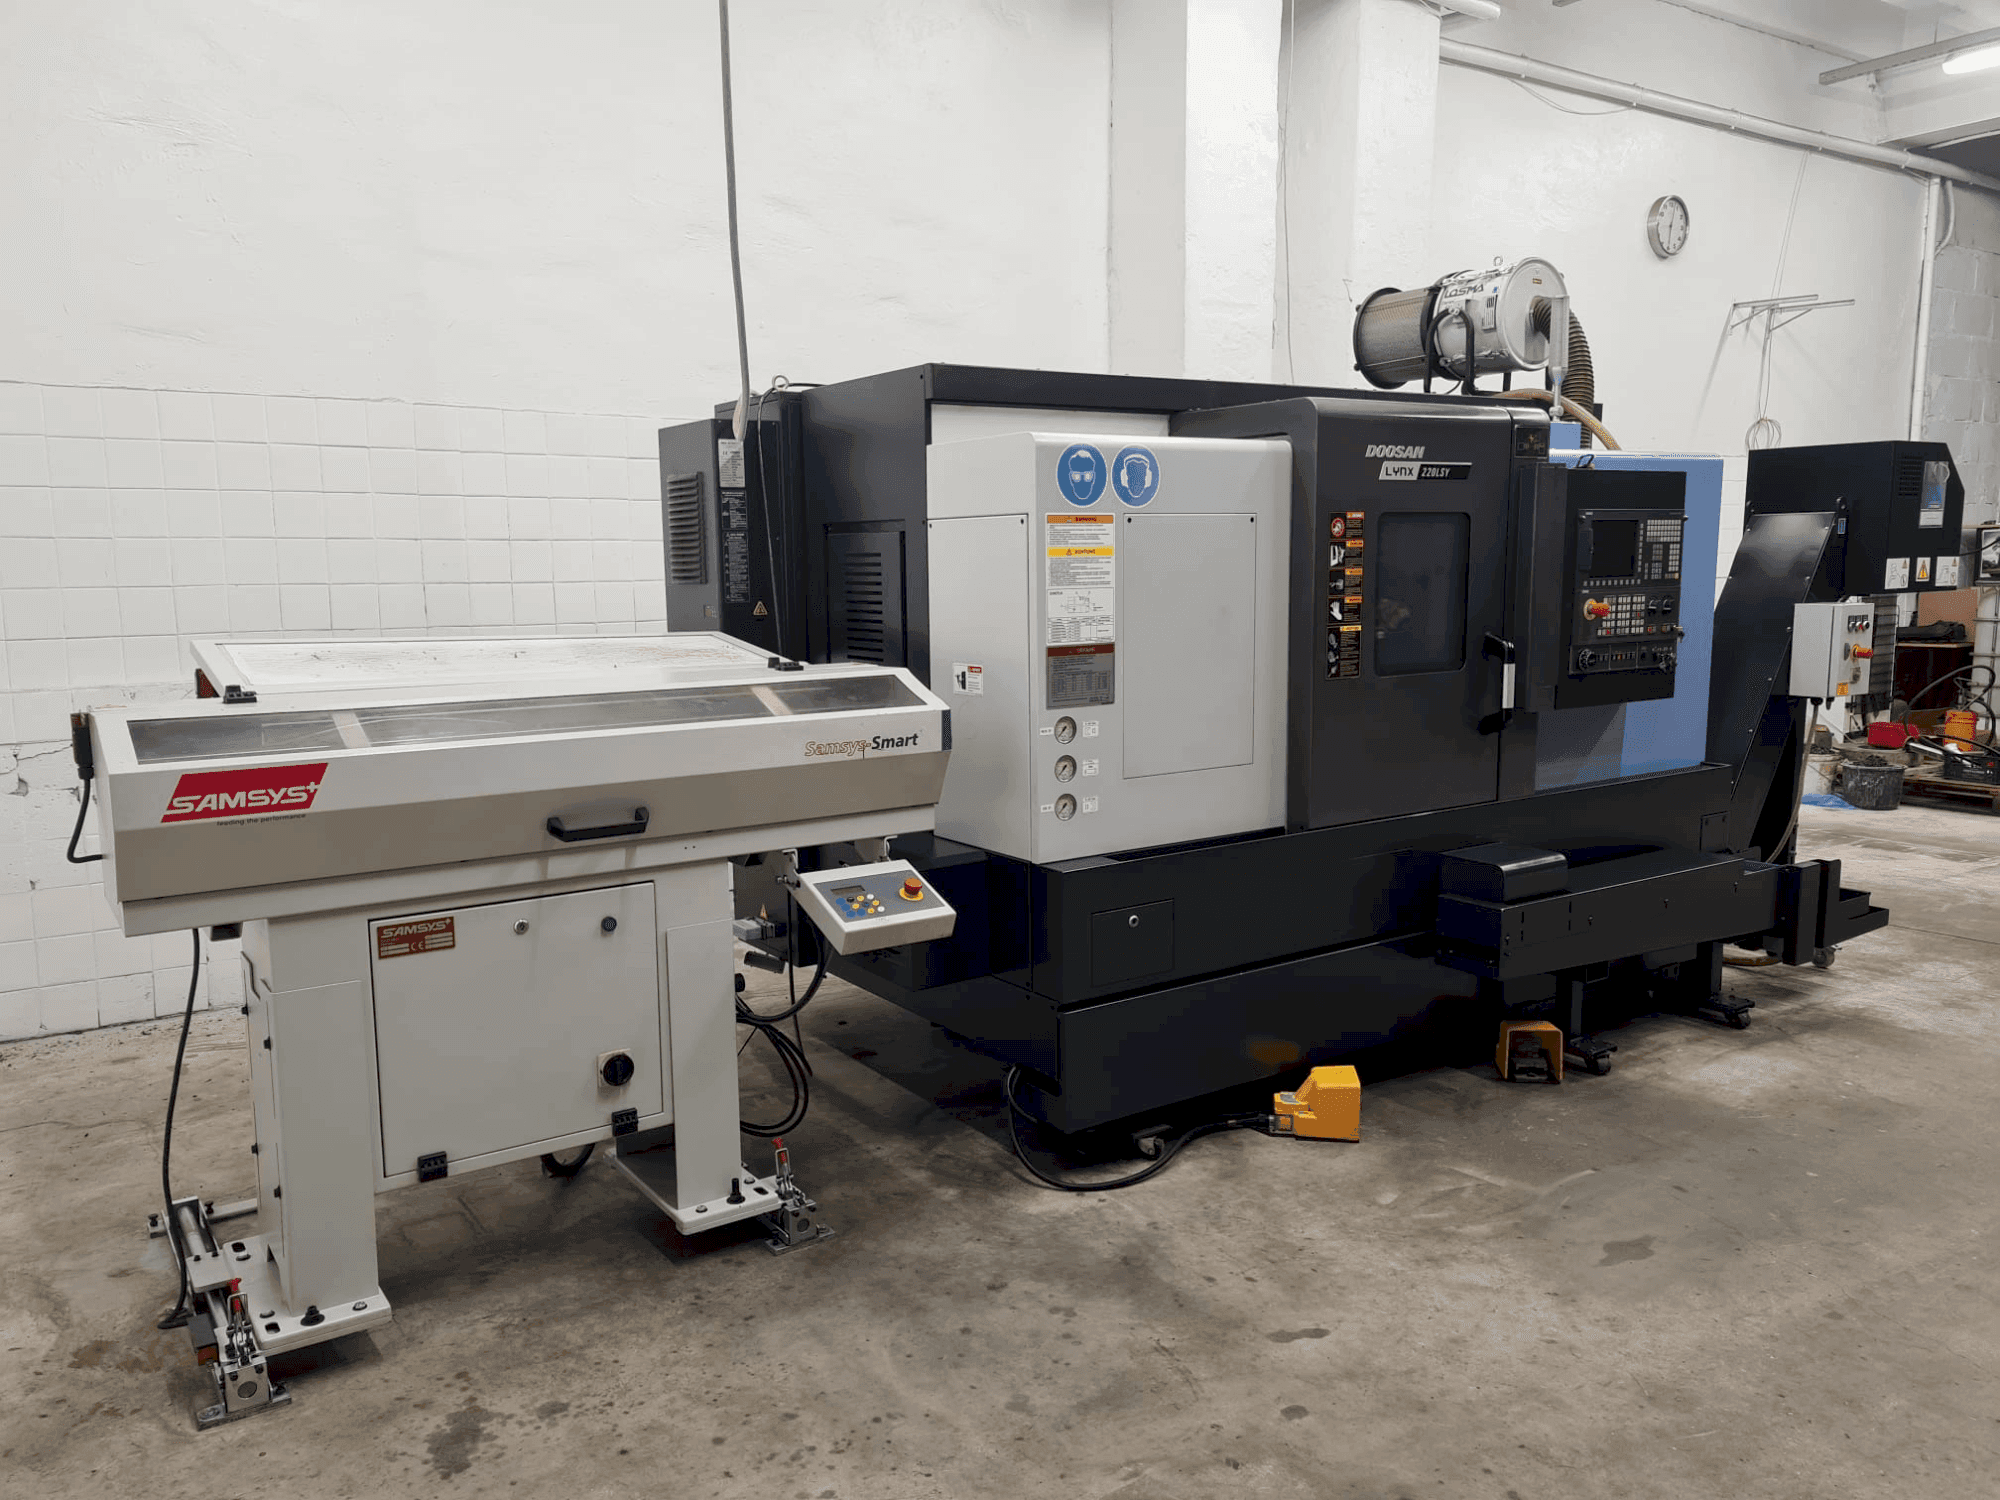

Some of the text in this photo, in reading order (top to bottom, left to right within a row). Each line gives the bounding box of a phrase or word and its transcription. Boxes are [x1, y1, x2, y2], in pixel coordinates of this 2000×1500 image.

[1444, 284, 1484, 299] LOSMA
[1365, 444, 1425, 459] DOOSAN
[1421, 467, 1451, 477] 220LSY
[246, 816, 259, 824] the
[260, 813, 307, 823] performance
